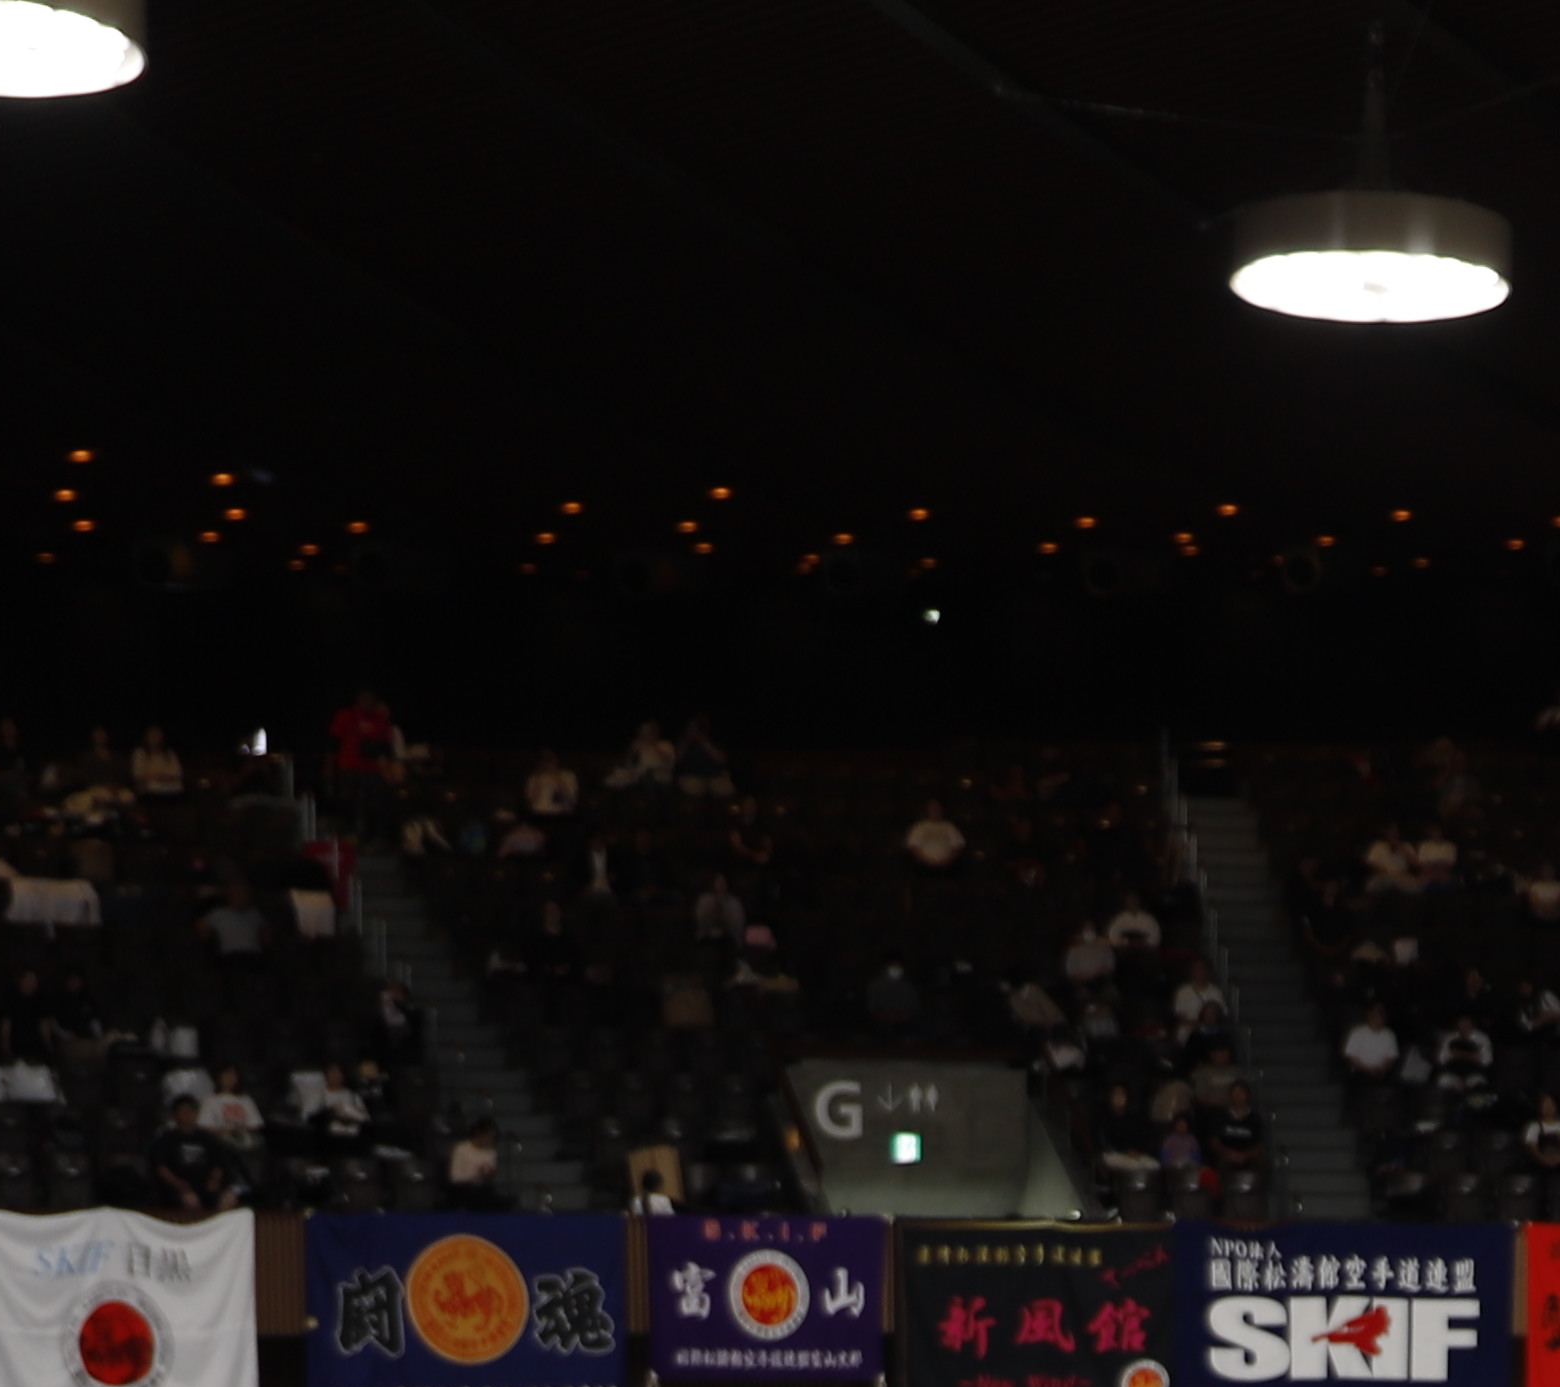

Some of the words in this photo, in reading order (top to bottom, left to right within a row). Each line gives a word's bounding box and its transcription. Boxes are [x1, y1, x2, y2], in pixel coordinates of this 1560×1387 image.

[815, 1080, 863, 1140] G
[35, 1241, 114, 1278] SKIF
[126, 1243, 191, 1282] 目黒
[1209, 1237, 1283, 1259] NPO法人
[672, 1261, 716, 1320] 富
[824, 1267, 865, 1318] 山
[1208, 1296, 1481, 1382] SKIF
